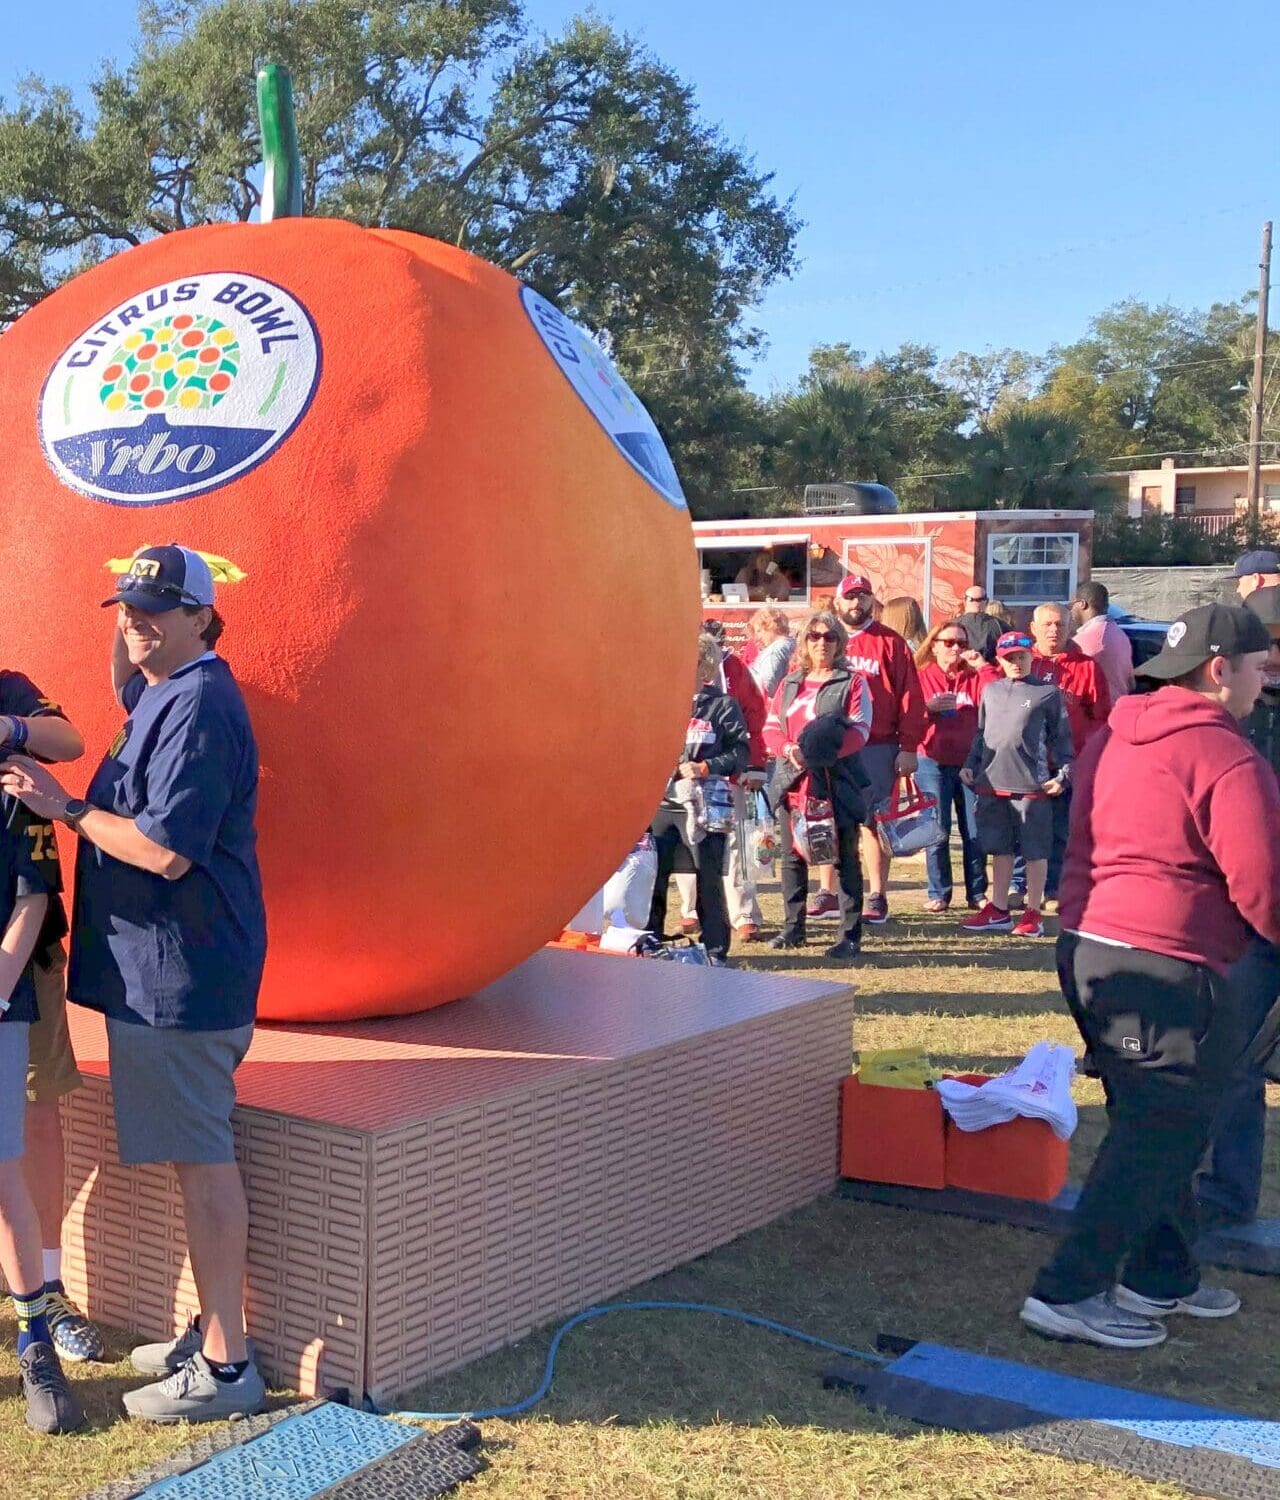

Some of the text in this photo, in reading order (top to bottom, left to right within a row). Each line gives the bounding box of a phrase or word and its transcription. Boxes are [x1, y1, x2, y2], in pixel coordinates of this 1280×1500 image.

[67, 281, 299, 368] CITRUS BOWL
[89, 431, 217, 476] Vrbo
